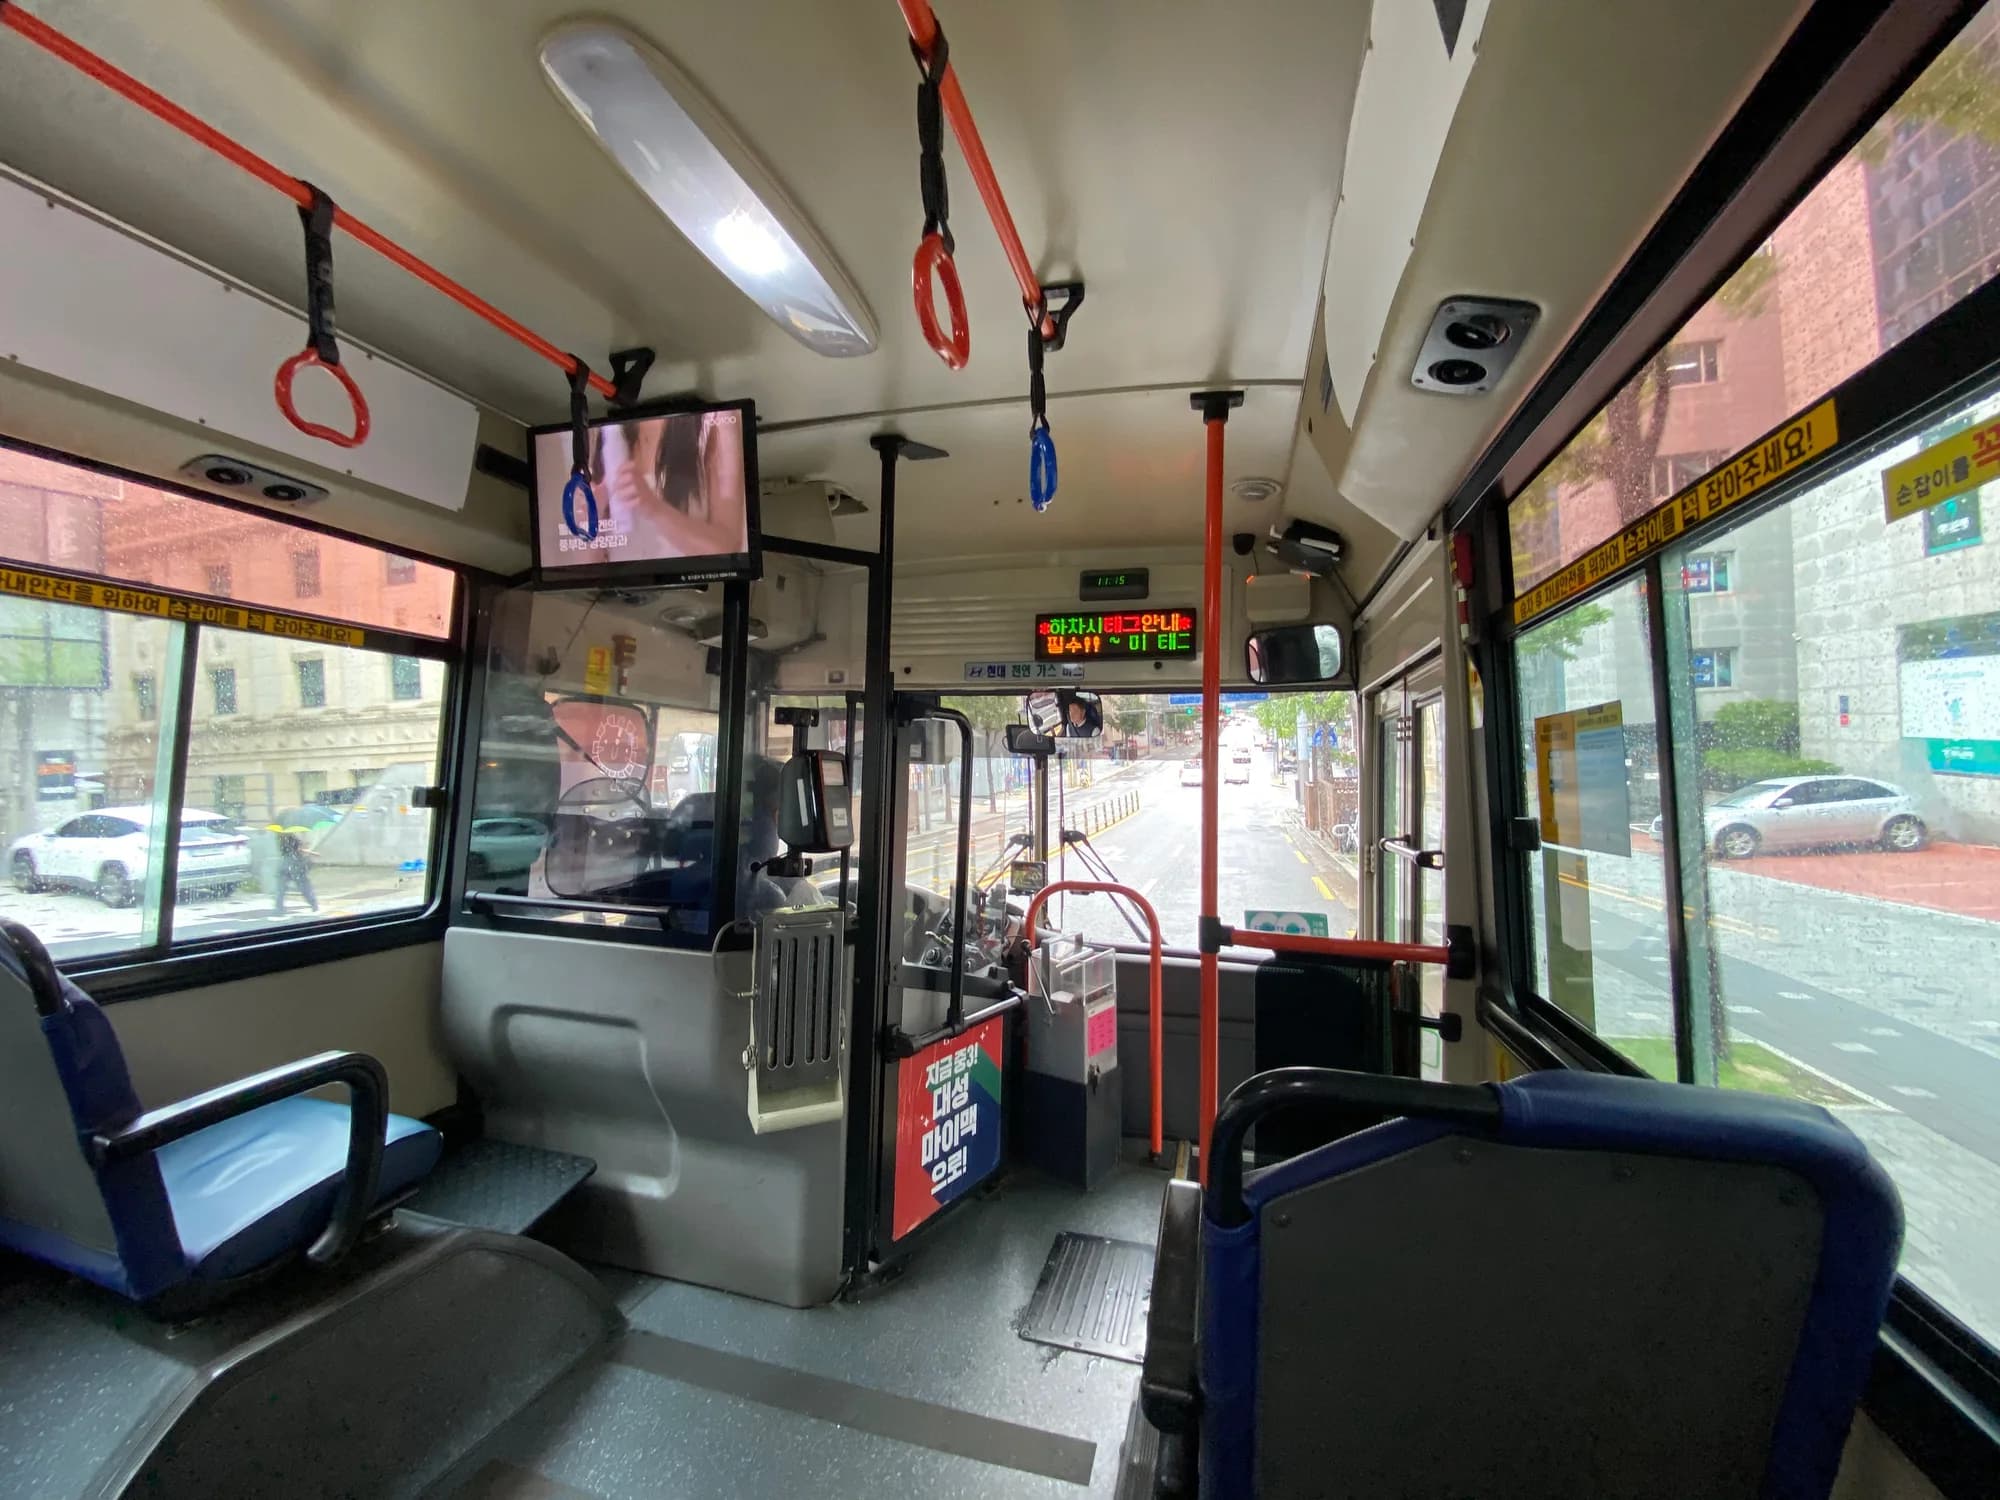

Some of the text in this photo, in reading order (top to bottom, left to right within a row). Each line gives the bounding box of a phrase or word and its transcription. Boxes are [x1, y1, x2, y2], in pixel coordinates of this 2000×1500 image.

[1588, 543, 1621, 578] 위하여
[1624, 506, 1675, 560] 손잡이를
[1682, 490, 1699, 525] 꼭
[1705, 420, 1814, 512] 잡아주세요!
[1896, 455, 1970, 507] 손잡이를
[103, 589, 161, 613] 위하여
[170, 602, 241, 626] 손잡이를
[273, 617, 351, 642] 잡아주세요!
[1047, 635, 1101, 654] 필수!!
[987, 664, 1006, 679] 현대
[1012, 664, 1031, 678] 천연
[1036, 664, 1057, 678] 가스
[932, 1071, 969, 1121] 대성
[921, 1103, 978, 1167] 마이맥
[931, 1146, 968, 1196] 으로!
